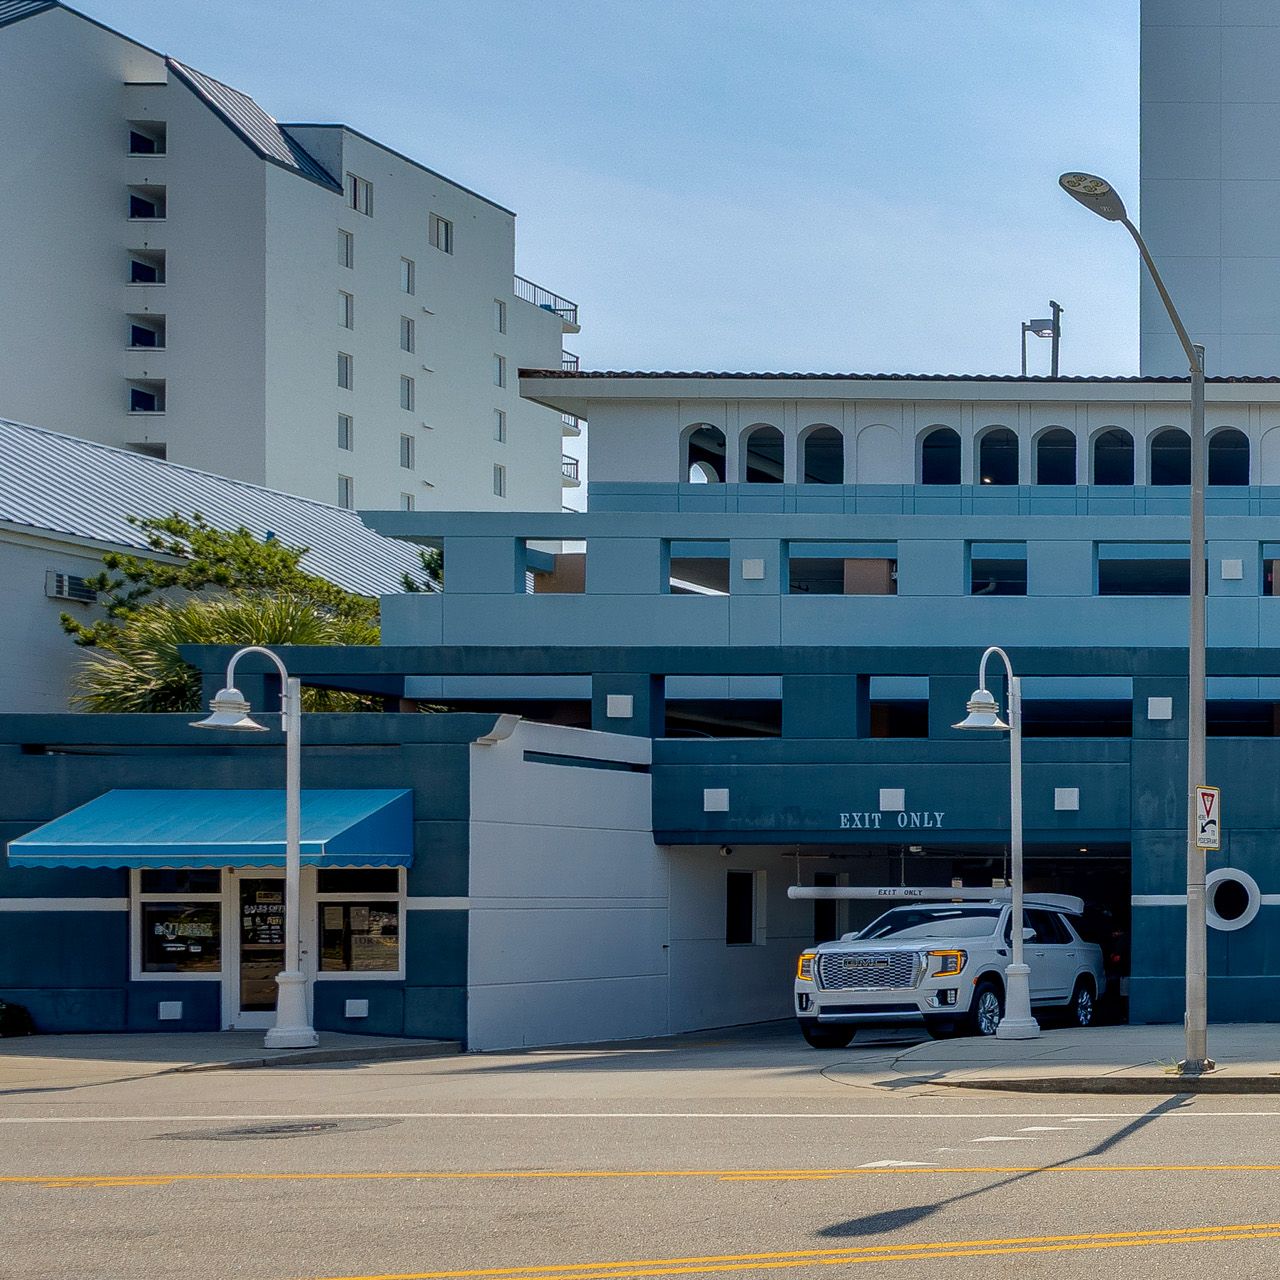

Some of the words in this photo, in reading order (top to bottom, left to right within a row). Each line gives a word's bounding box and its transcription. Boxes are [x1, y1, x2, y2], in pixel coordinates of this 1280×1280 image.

[839, 812, 882, 828] EXIT
[897, 811, 945, 828] ONLY
[843, 957, 890, 967] GMC
